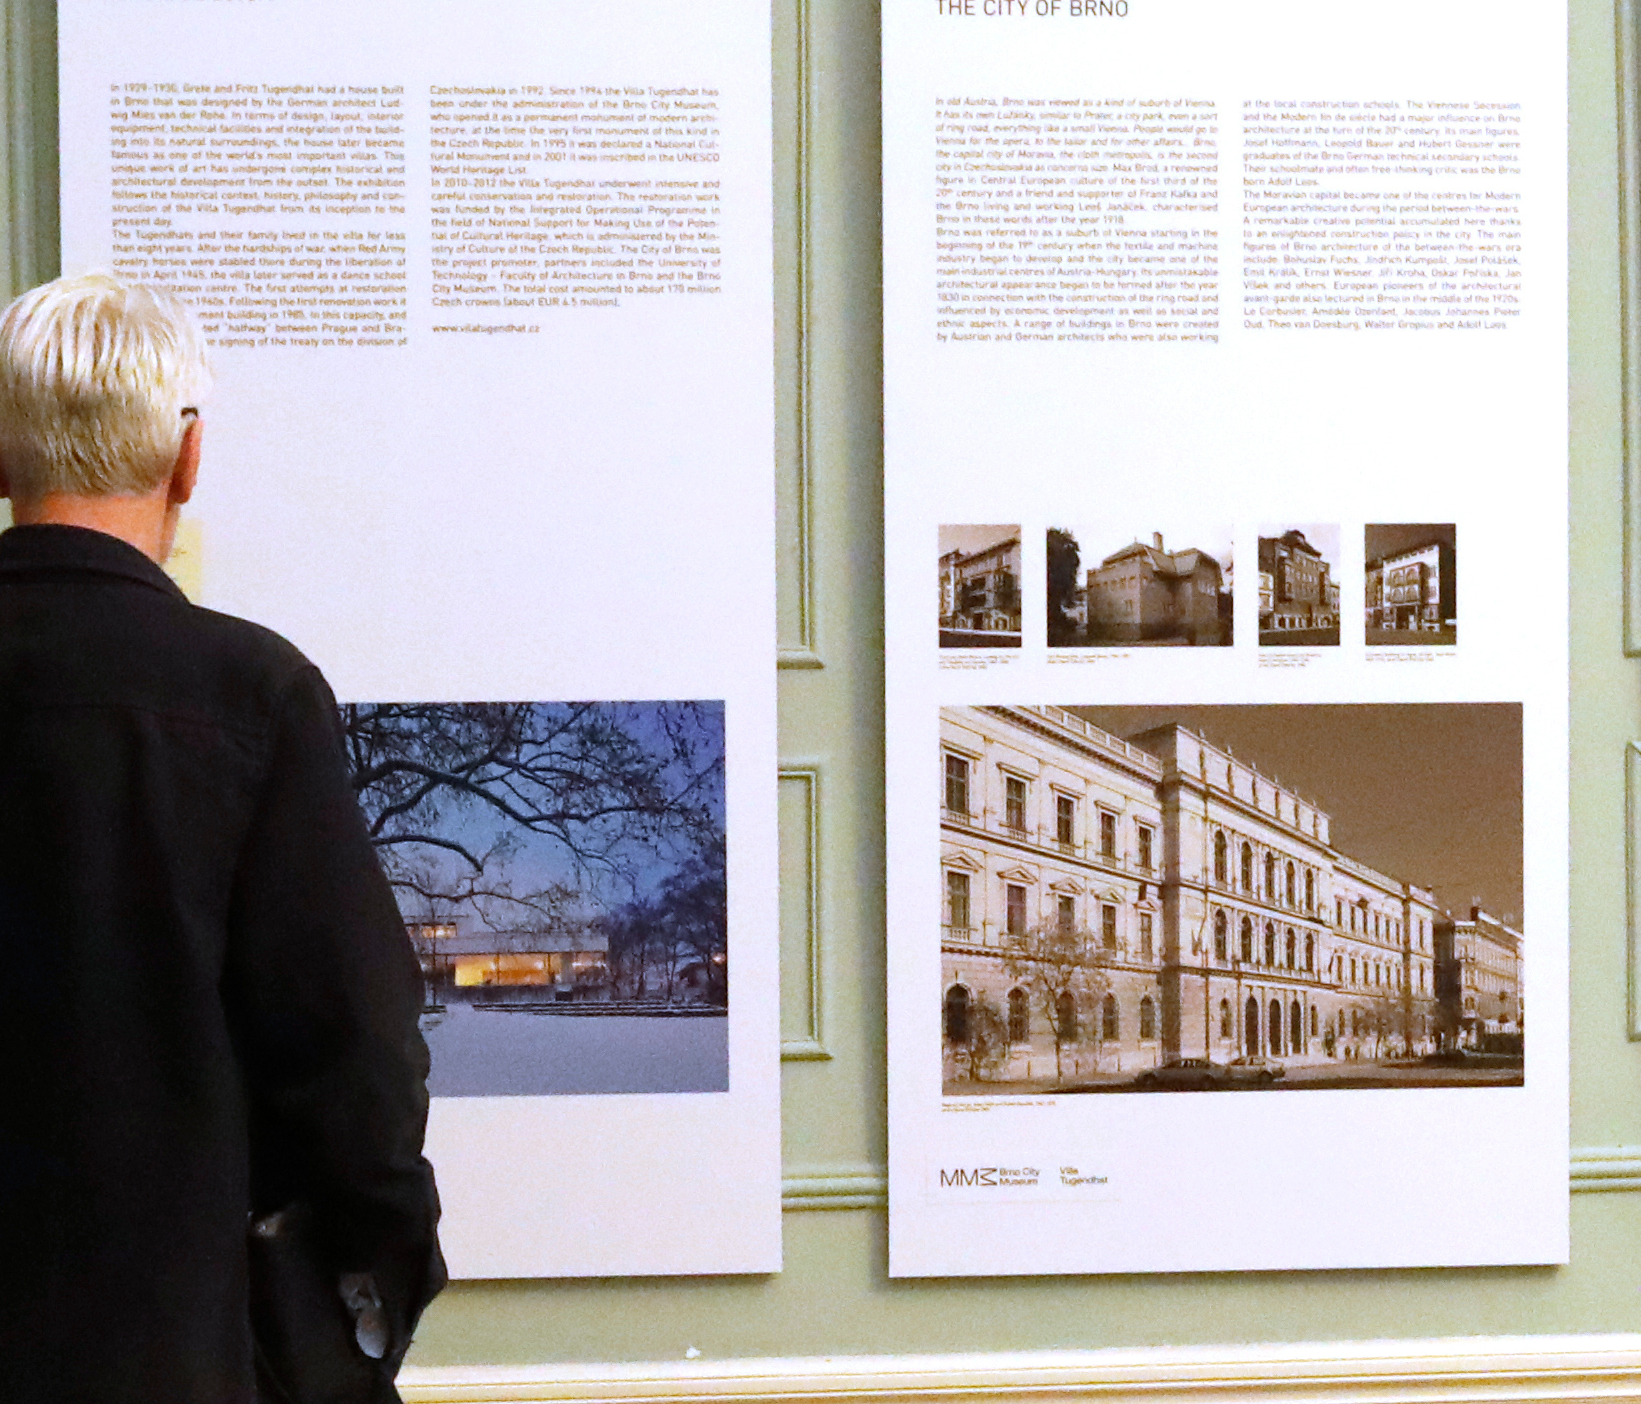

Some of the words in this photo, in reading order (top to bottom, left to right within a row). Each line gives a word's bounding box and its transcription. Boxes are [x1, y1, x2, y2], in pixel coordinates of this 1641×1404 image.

[430, 85, 506, 95] Czechoslovakia
[508, 85, 518, 95] in
[549, 85, 576, 95] Since
[605, 85, 621, 96] the
[623, 86, 645, 96] Villa
[648, 86, 699, 99] Tugendhat
[701, 86, 719, 97] has
[110, 96, 120, 106] in
[124, 96, 149, 107] Brno
[153, 96, 173, 107] that
[178, 99, 197, 107] was
[201, 97, 247, 109] designed
[251, 97, 262, 109] by
[267, 97, 283, 107] the
[287, 97, 328, 107] German
[332, 97, 376, 108] architect
[430, 98, 454, 108] been
[459, 98, 487, 109] under
[492, 98, 508, 109] the
[512, 98, 584, 109] administration
[588, 99, 598, 109] of
[603, 99, 618, 109] the
[622, 99, 647, 109] Brno
[651, 99, 670, 112] City
[1244, 137, 1268, 148] Josef
[1325, 138, 1362, 150] Leopold
[1366, 138, 1393, 148] Bauer
[1398, 138, 1415, 148] and
[1419, 138, 1451, 149] Hubert
[1498, 141, 1520, 149] were
[431, 177, 440, 187] In
[499, 177, 515, 187] the
[518, 177, 540, 188] Villa
[544, 178, 596, 190] Tugendhat
[598, 178, 651, 188] underwent
[655, 178, 699, 189] intensive
[702, 178, 720, 189] and
[936, 175, 963, 187] figure
[968, 175, 976, 185] in
[981, 175, 1016, 185] Central
[1020, 175, 1066, 188] European
[1070, 175, 1104, 186] culture
[1107, 175, 1117, 186] of
[1121, 175, 1136, 185] the
[1140, 175, 1160, 186] first
[1164, 175, 1186, 186] third
[1190, 175, 1199, 186] of
[1203, 175, 1217, 186] the
[431, 191, 466, 201] careful
[469, 191, 532, 201] conservation
[536, 191, 554, 201] and
[617, 191, 635, 202] The
[638, 191, 692, 202] restoration
[695, 192, 720, 202] work
[1244, 189, 1260, 199] The
[1263, 189, 1306, 200] Moravian
[1310, 190, 1340, 202] capital
[1343, 190, 1380, 200] became
[1383, 192, 1400, 200] one
[1403, 190, 1411, 200] of
[1414, 190, 1429, 200] the
[1432, 190, 1467, 200] centres
[1469, 190, 1481, 200] for
[1485, 190, 1521, 200] Modern
[1243, 202, 1288, 215] European
[1290, 203, 1348, 213] architecture
[1350, 203, 1380, 215] during
[1383, 203, 1397, 213] the
[1399, 203, 1429, 215] period
[936, 213, 959, 224] Brno
[962, 214, 971, 224] in
[974, 214, 1000, 224] these
[1003, 214, 1032, 224] words
[1036, 214, 1057, 224] after
[1061, 214, 1076, 224] the
[1079, 216, 1099, 226] year
[113, 229, 131, 240] The
[136, 229, 193, 242] Tugendhats
[198, 229, 216, 240] and
[220, 230, 243, 240] their
[248, 230, 278, 242] family
[309, 230, 319, 240] in
[323, 230, 338, 240] the
[343, 230, 363, 240] villa
[367, 230, 381, 240] for
[385, 230, 405, 240] less
[936, 227, 960, 237] Brno
[963, 229, 982, 237] was
[986, 227, 1026, 237] referred
[1029, 227, 1039, 237] to
[1042, 229, 1053, 238] as
[1056, 229, 1062, 238] a
[1066, 227, 1099, 238] suburb
[1102, 227, 1112, 238] of
[1115, 227, 1147, 238] Vienna
[1151, 228, 1188, 240] starting
[1191, 228, 1199, 238] in
[1203, 228, 1218, 238] the
[432, 296, 462, 307] Czech
[465, 298, 501, 307] crowns
[538, 296, 559, 307] EUR
[1268, 319, 1291, 329] Theo
[1294, 321, 1310, 329] van
[1365, 319, 1394, 329] Walter
[1398, 319, 1434, 332] Gropius
[1437, 319, 1455, 330] and
[1458, 319, 1481, 330] Adolf
[937, 331, 947, 344] by
[951, 331, 991, 342] Austrian
[995, 331, 1012, 342] and
[1015, 331, 1054, 342] German
[1057, 331, 1105, 342] architects
[1108, 331, 1128, 342] who
[1131, 334, 1154, 342] were
[1157, 332, 1178, 342] also
[1181, 332, 1219, 344] working
[999, 1168, 1021, 1177] Brno
[1023, 1167, 1040, 1177] City
[999, 1177, 1039, 1186] Museum
[1060, 1176, 1108, 1187] Tugendhat
